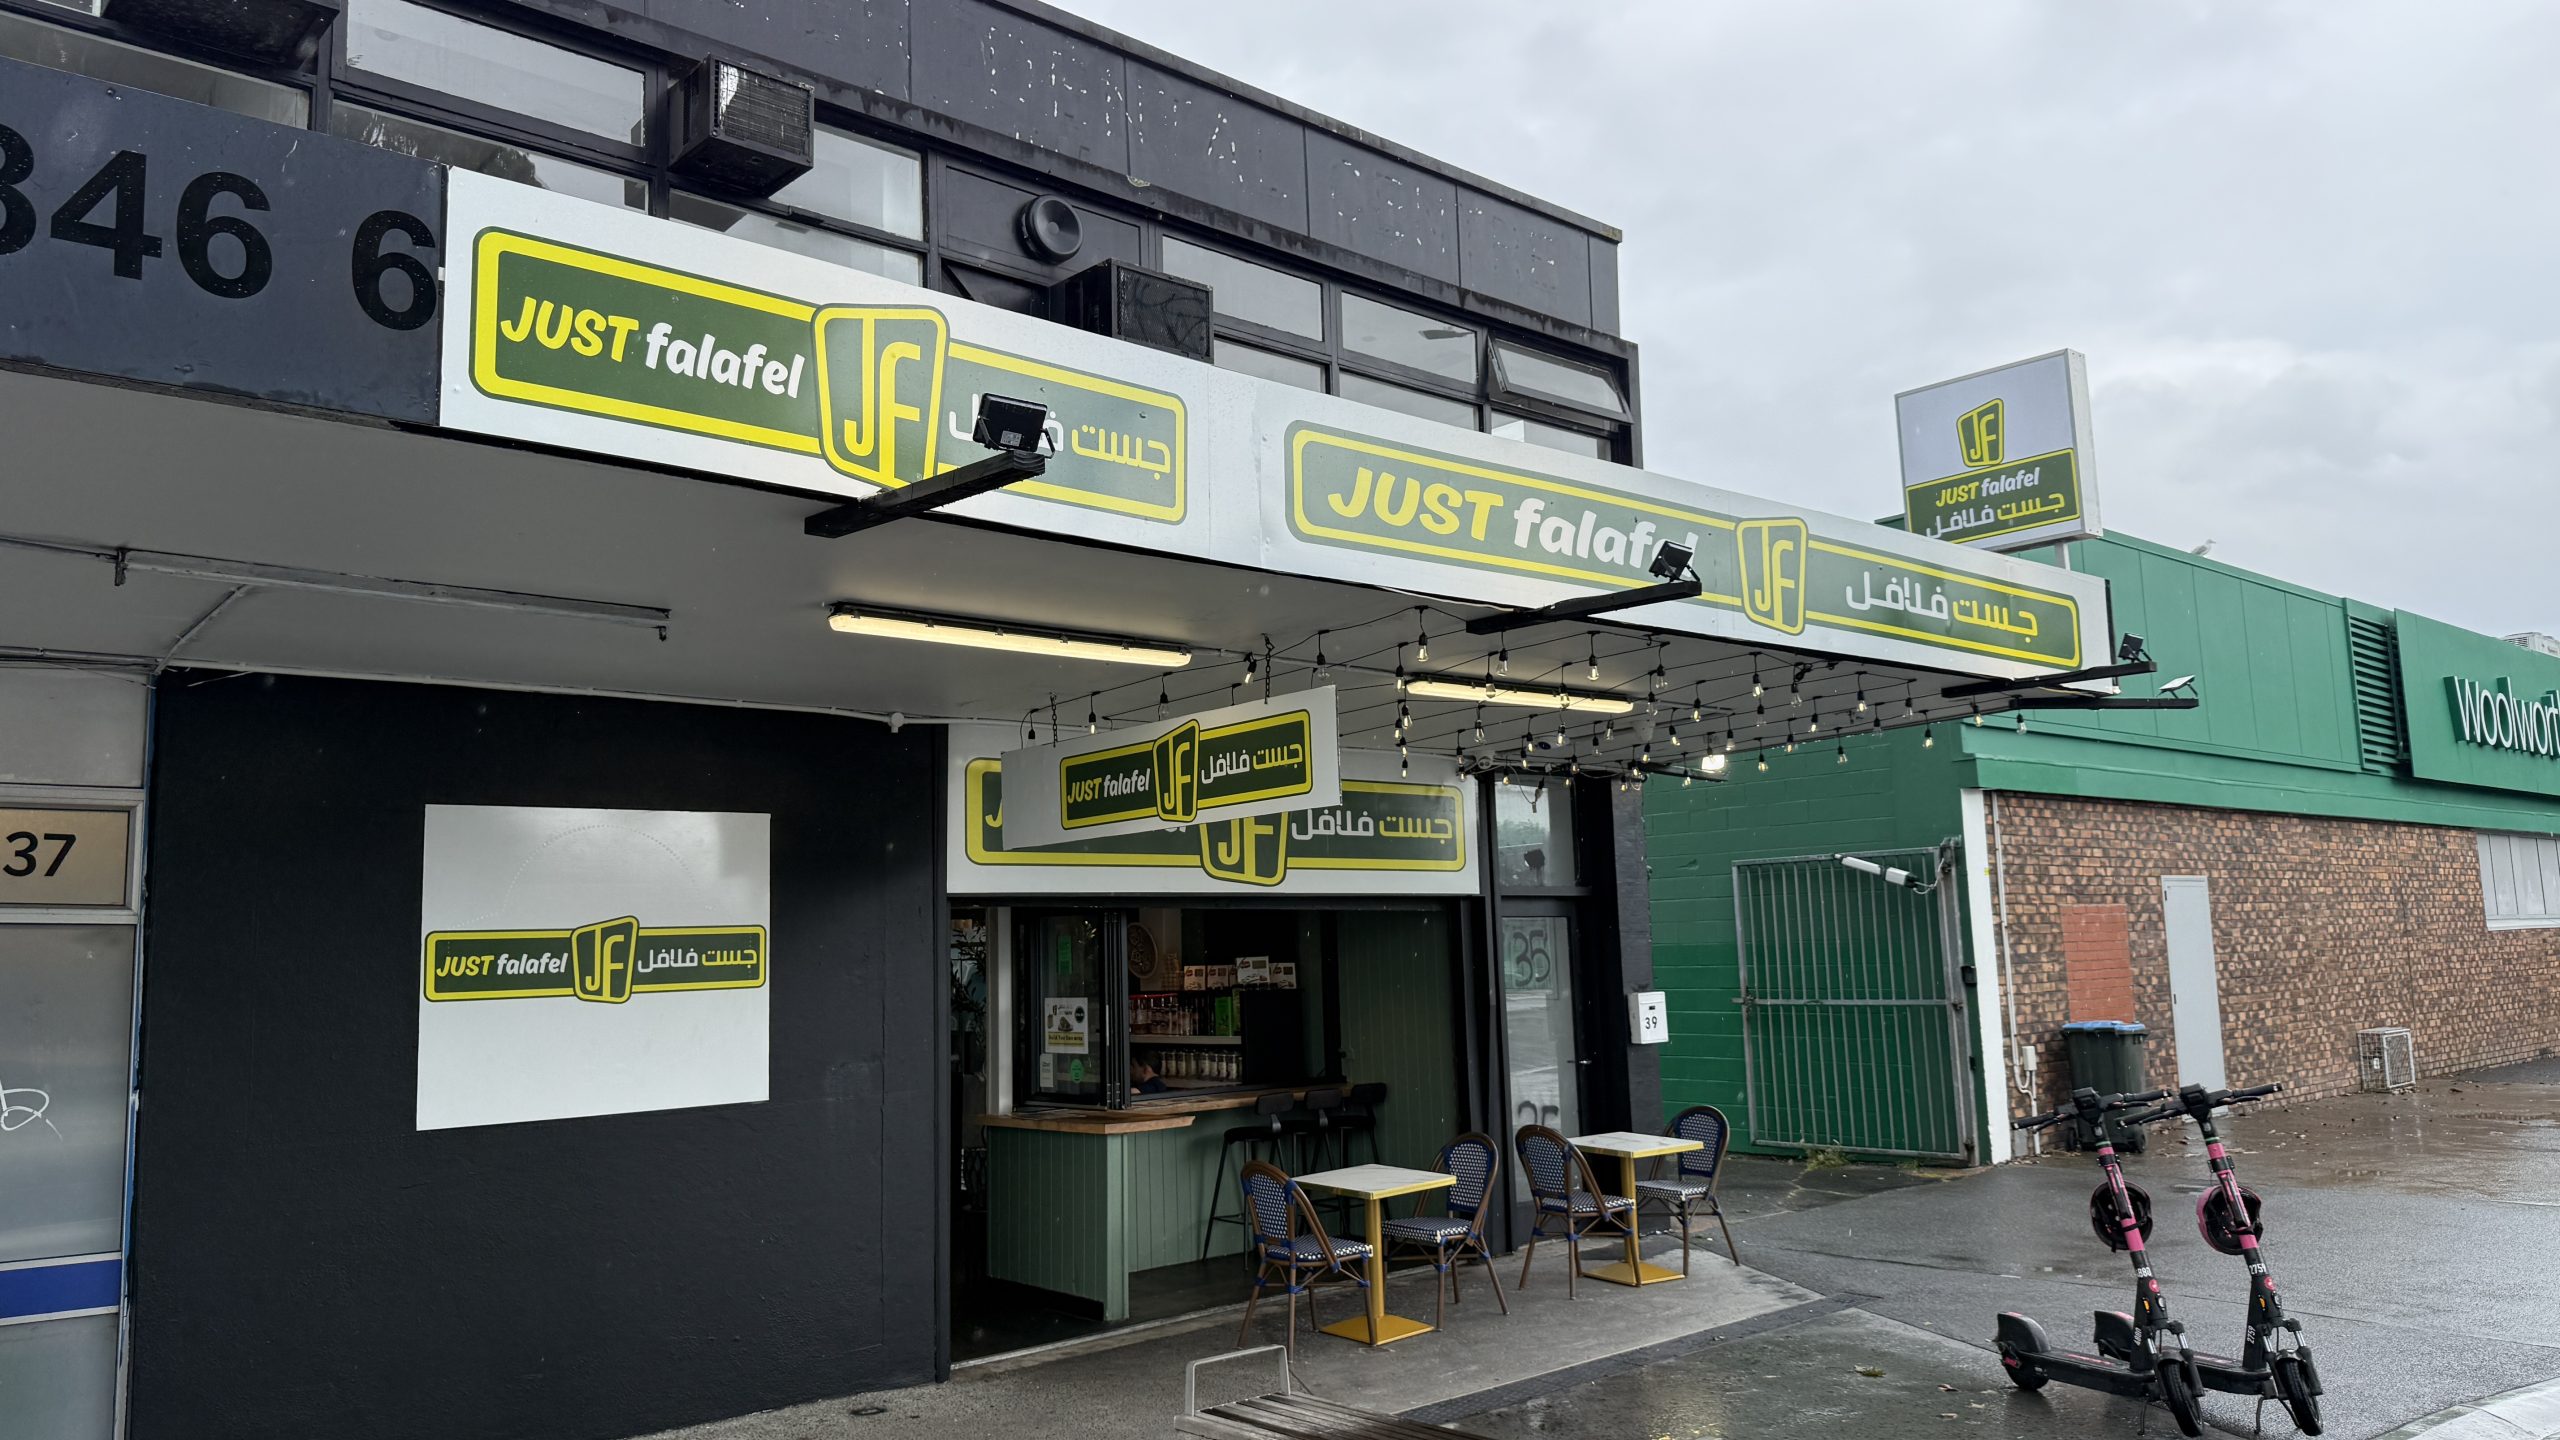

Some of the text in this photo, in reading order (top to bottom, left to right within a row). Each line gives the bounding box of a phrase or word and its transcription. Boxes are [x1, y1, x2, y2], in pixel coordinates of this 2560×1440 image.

[351, 210, 437, 331] 6
[500, 296, 805, 398] JUST falafel
[1071, 424, 1171, 480] جست
[1935, 467, 2040, 507] JUST falafel
[1328, 465, 1698, 577] JUST falafl
[1926, 493, 2065, 539] جست فلافل
[1845, 570, 2038, 643] جست فلافل
[2450, 675, 2560, 756] Woolwort
[1067, 768, 1150, 803] JUST falafel
[1201, 743, 1303, 784] جست فلافل
[1292, 809, 1453, 845] جست فلافل
[3, 831, 77, 878] 37
[436, 953, 568, 978] JUST falafel
[638, 948, 757, 973] جست فلافل
[1513, 929, 1551, 987] 35
[1644, 1016, 1658, 1030] 39
[2137, 1267, 2152, 1278] 880
